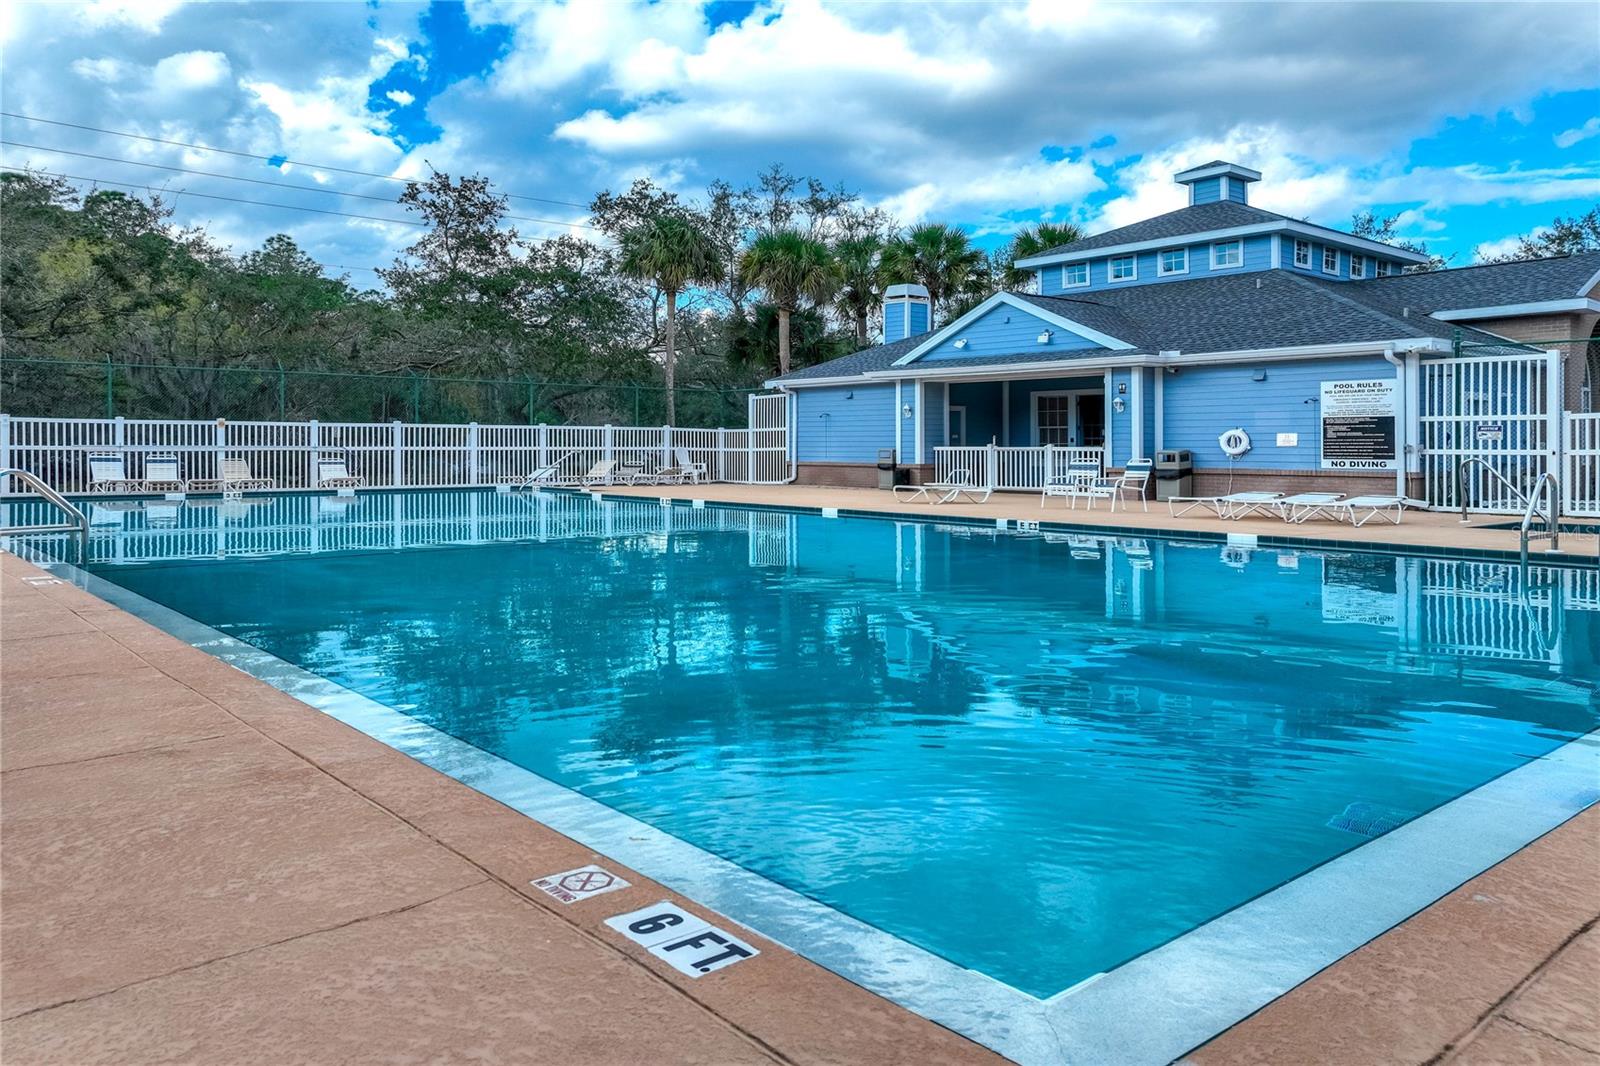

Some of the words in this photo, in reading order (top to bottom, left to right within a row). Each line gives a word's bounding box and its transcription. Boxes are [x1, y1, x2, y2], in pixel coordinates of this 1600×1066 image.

[1349, 460, 1387, 468] DIVING
[534, 879, 552, 887] NO
[545, 885, 577, 902] DIVING
[628, 912, 684, 935] 6
